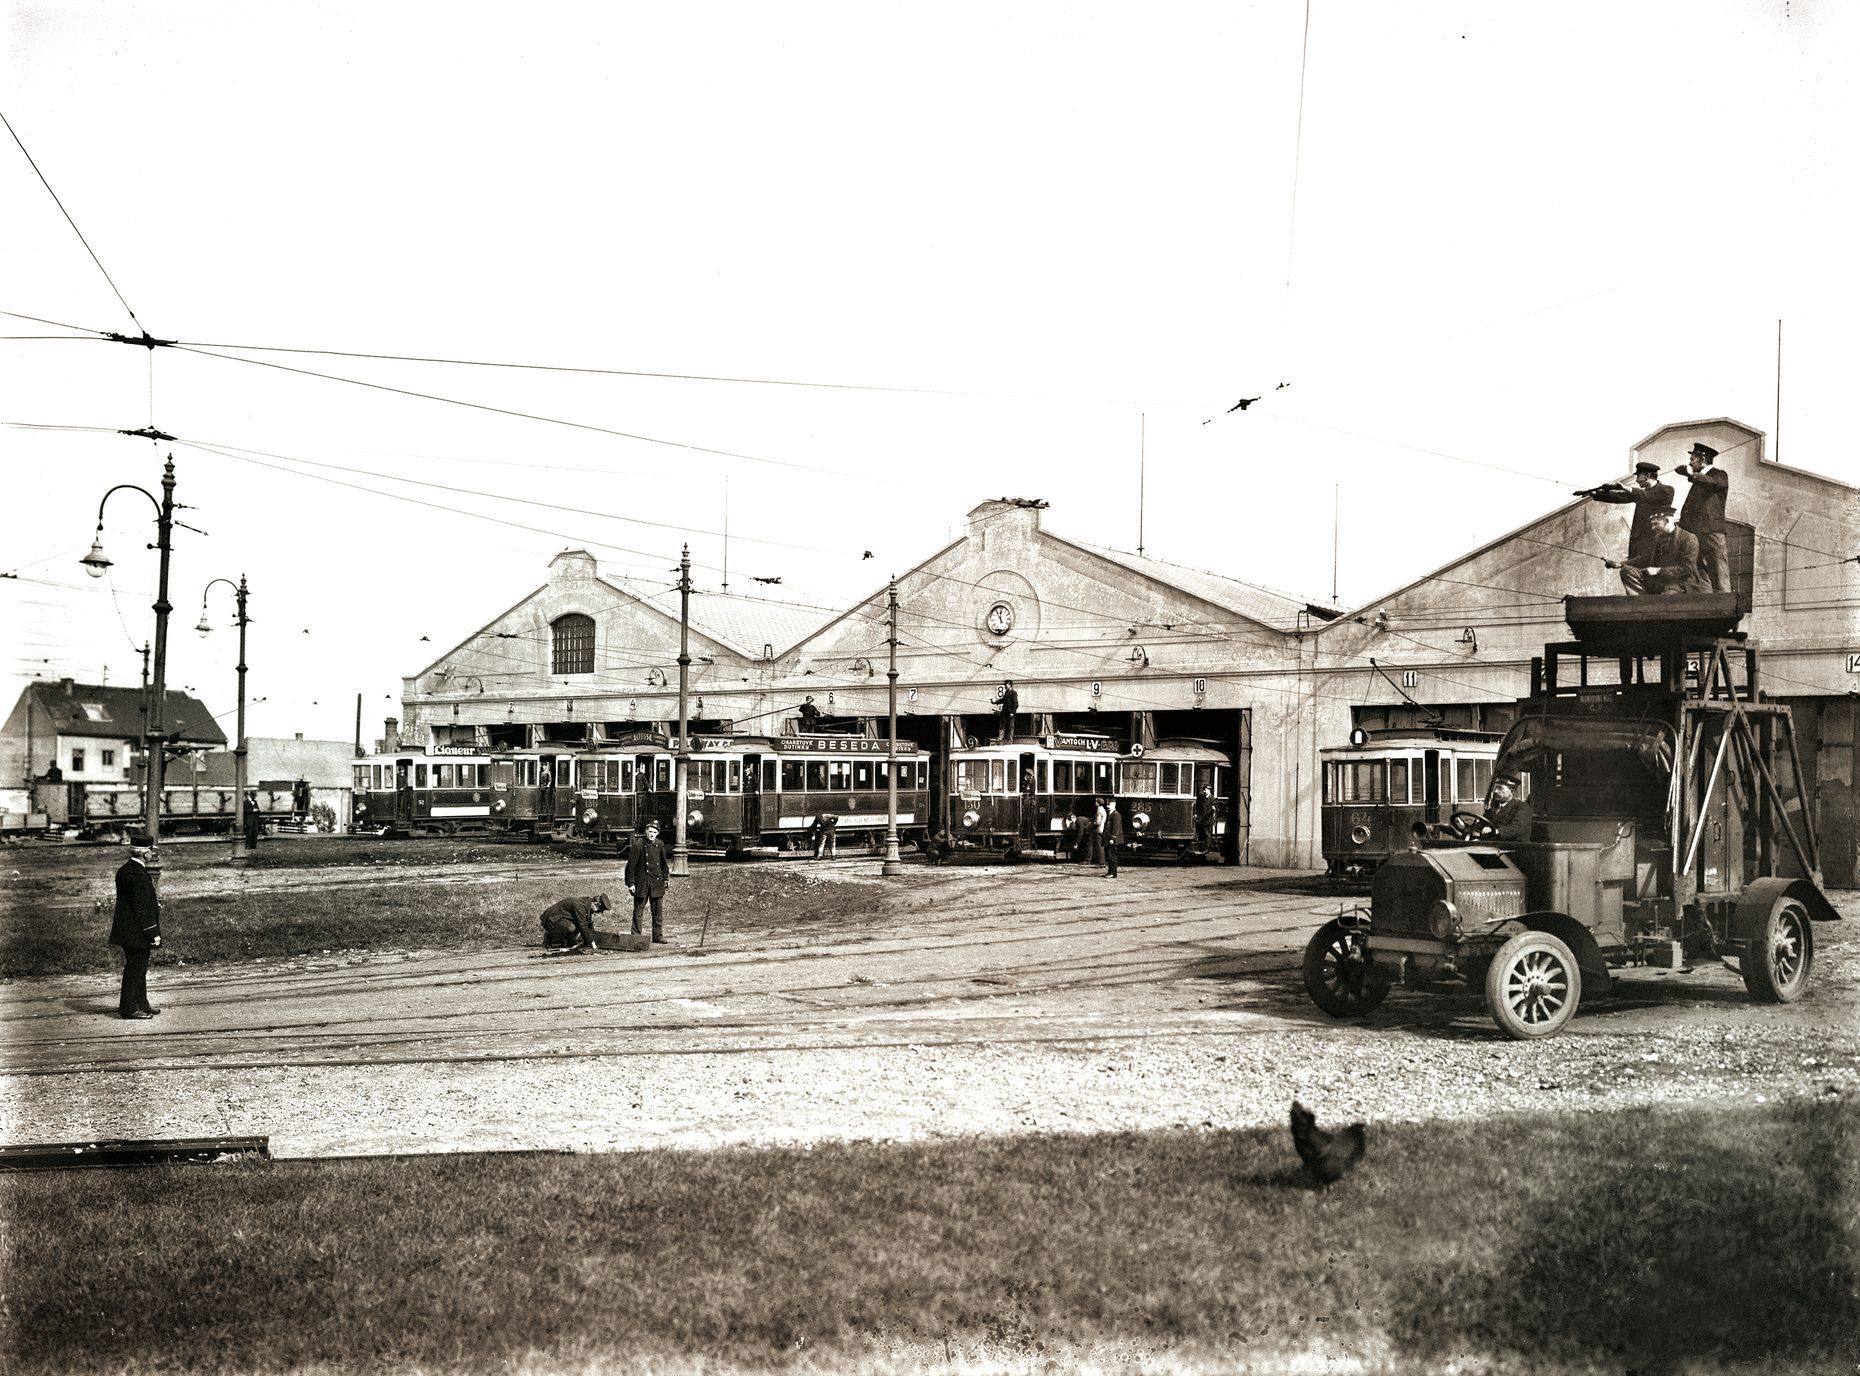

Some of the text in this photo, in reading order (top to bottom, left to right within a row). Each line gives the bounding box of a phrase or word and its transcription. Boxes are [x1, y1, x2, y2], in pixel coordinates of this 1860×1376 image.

[1405, 671, 1415, 687] 11
[1093, 683, 1100, 694] 9
[1195, 679, 1205, 692] 10
[910, 689, 917, 700] 7
[997, 686, 1004, 697] 8
[828, 692, 834, 703] 6
[818, 740, 880, 750] BESEDA
[1131, 801, 1152, 812] 285
